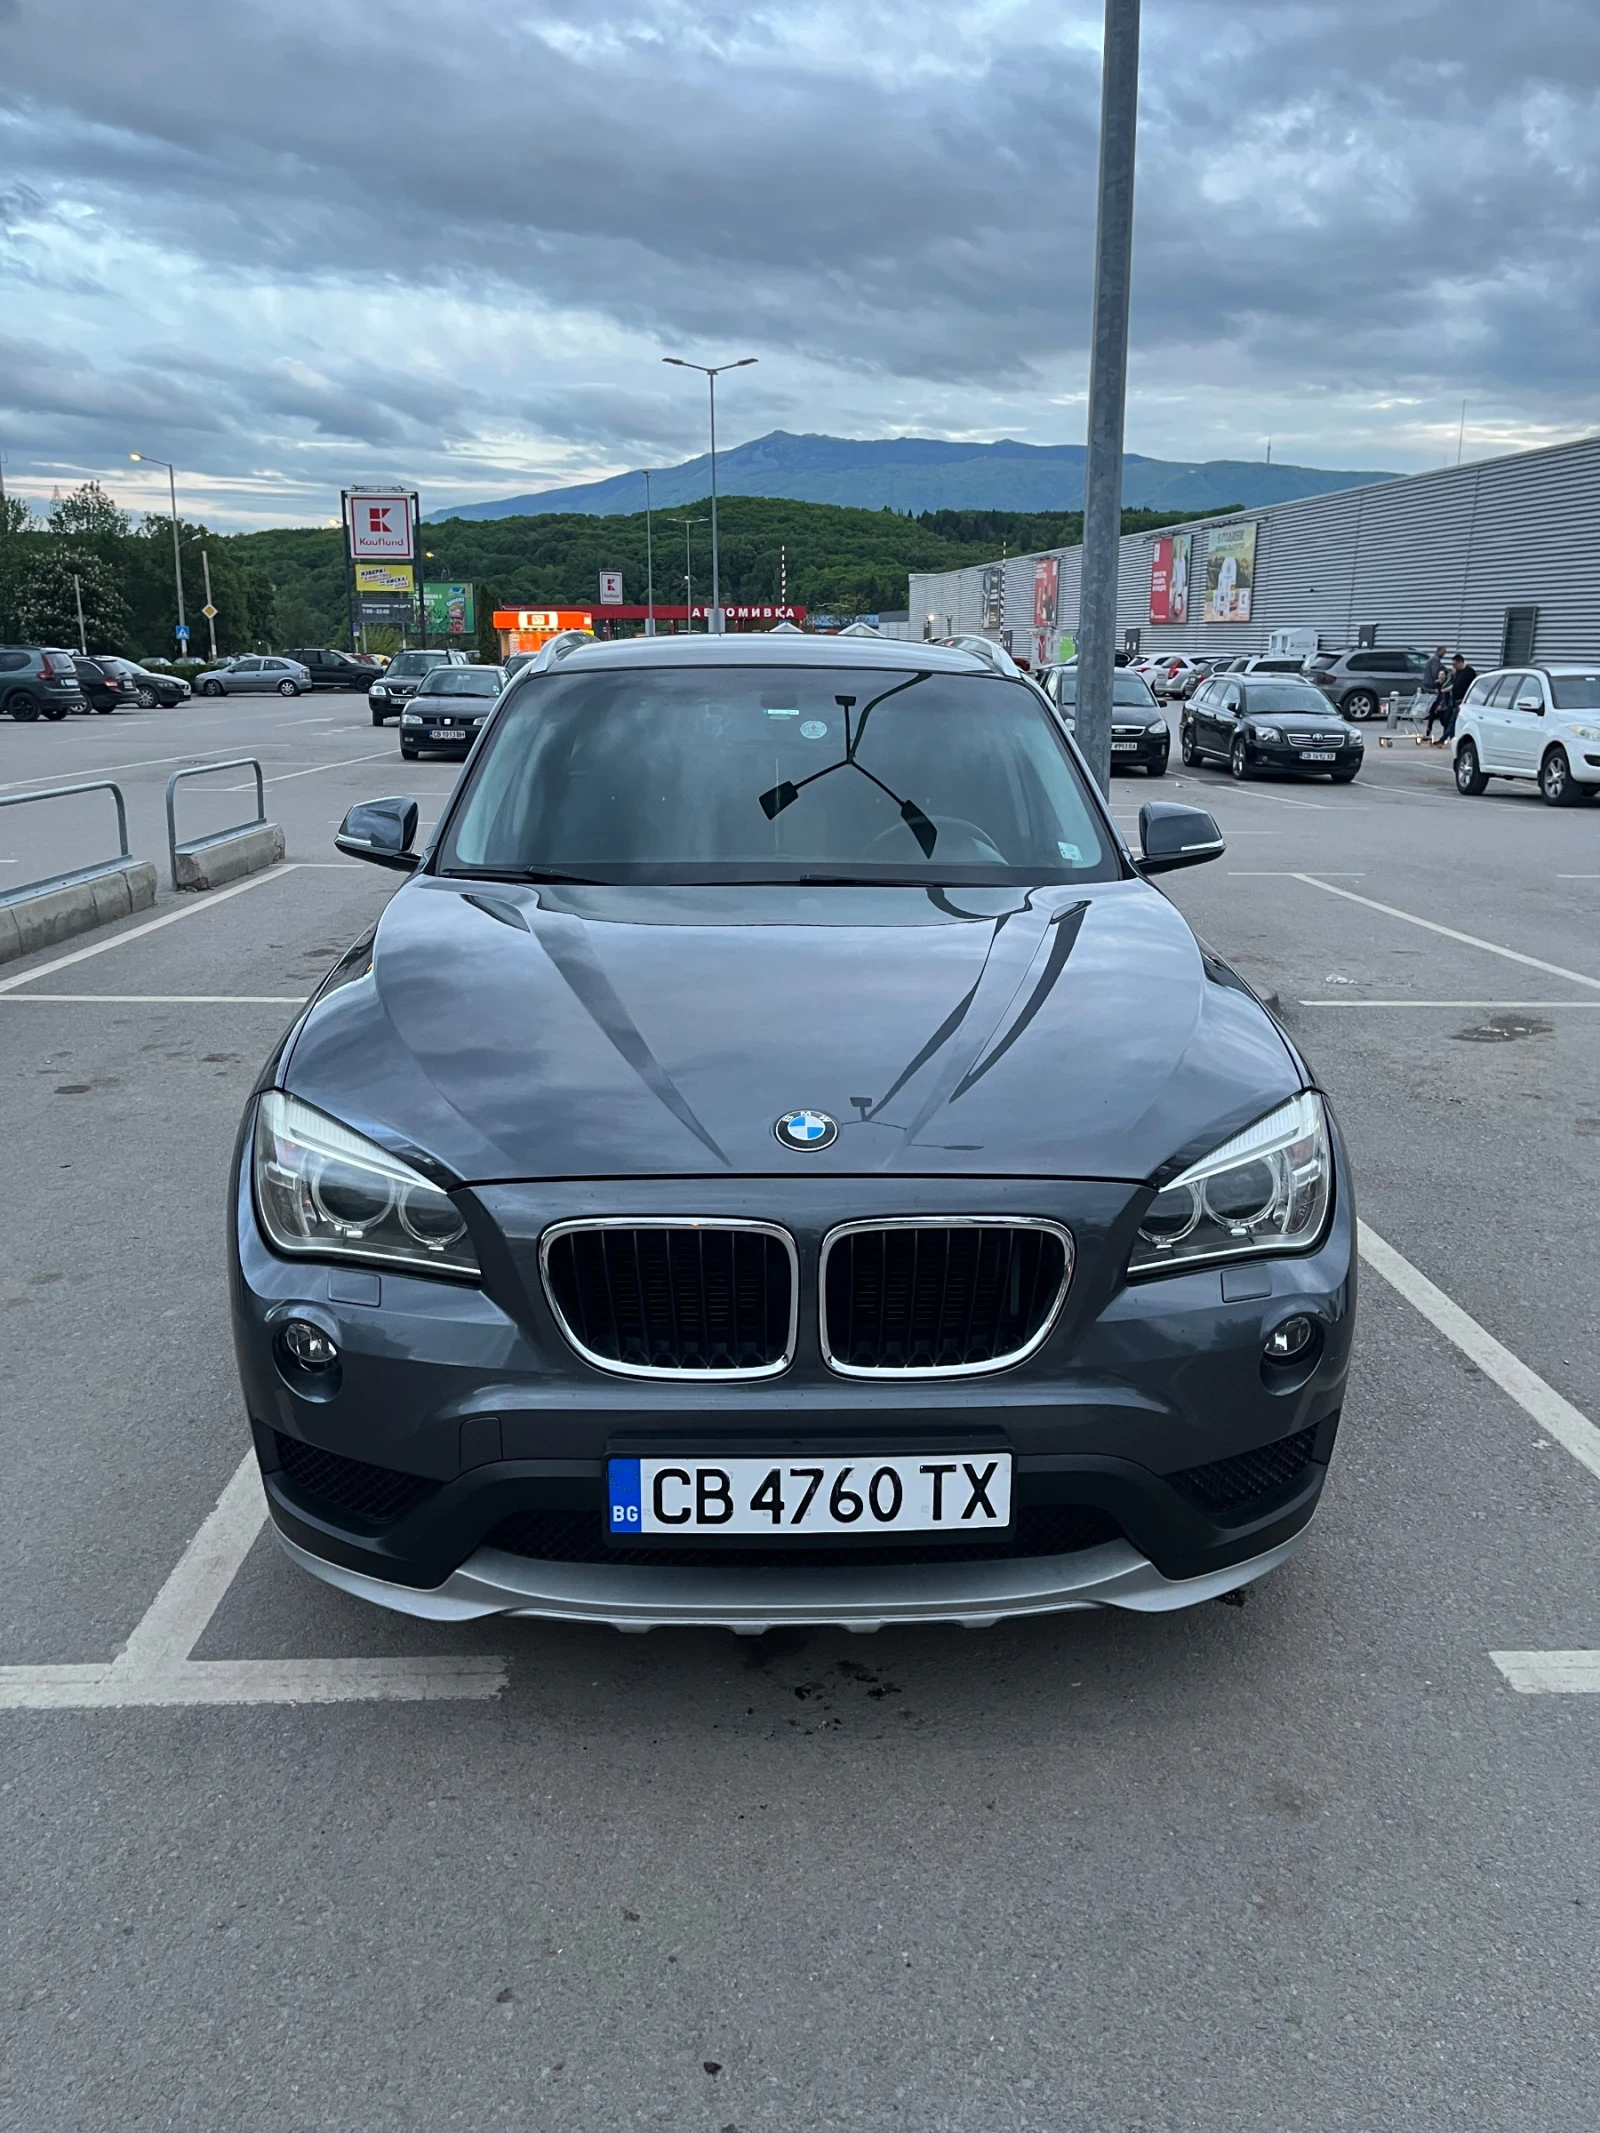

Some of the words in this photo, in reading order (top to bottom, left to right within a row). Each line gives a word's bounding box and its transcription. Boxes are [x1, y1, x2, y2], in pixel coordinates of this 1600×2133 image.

[359, 537, 404, 546] Kaufland
[360, 568, 383, 576] ИЗБЕРИ
[691, 607, 795, 618] АВОМИВКА
[780, 1111, 832, 1122] BMW
[652, 1468, 735, 1525] CB
[749, 1466, 904, 1525] 4760
[919, 1462, 999, 1521] TX
[612, 1506, 639, 1523] BG
